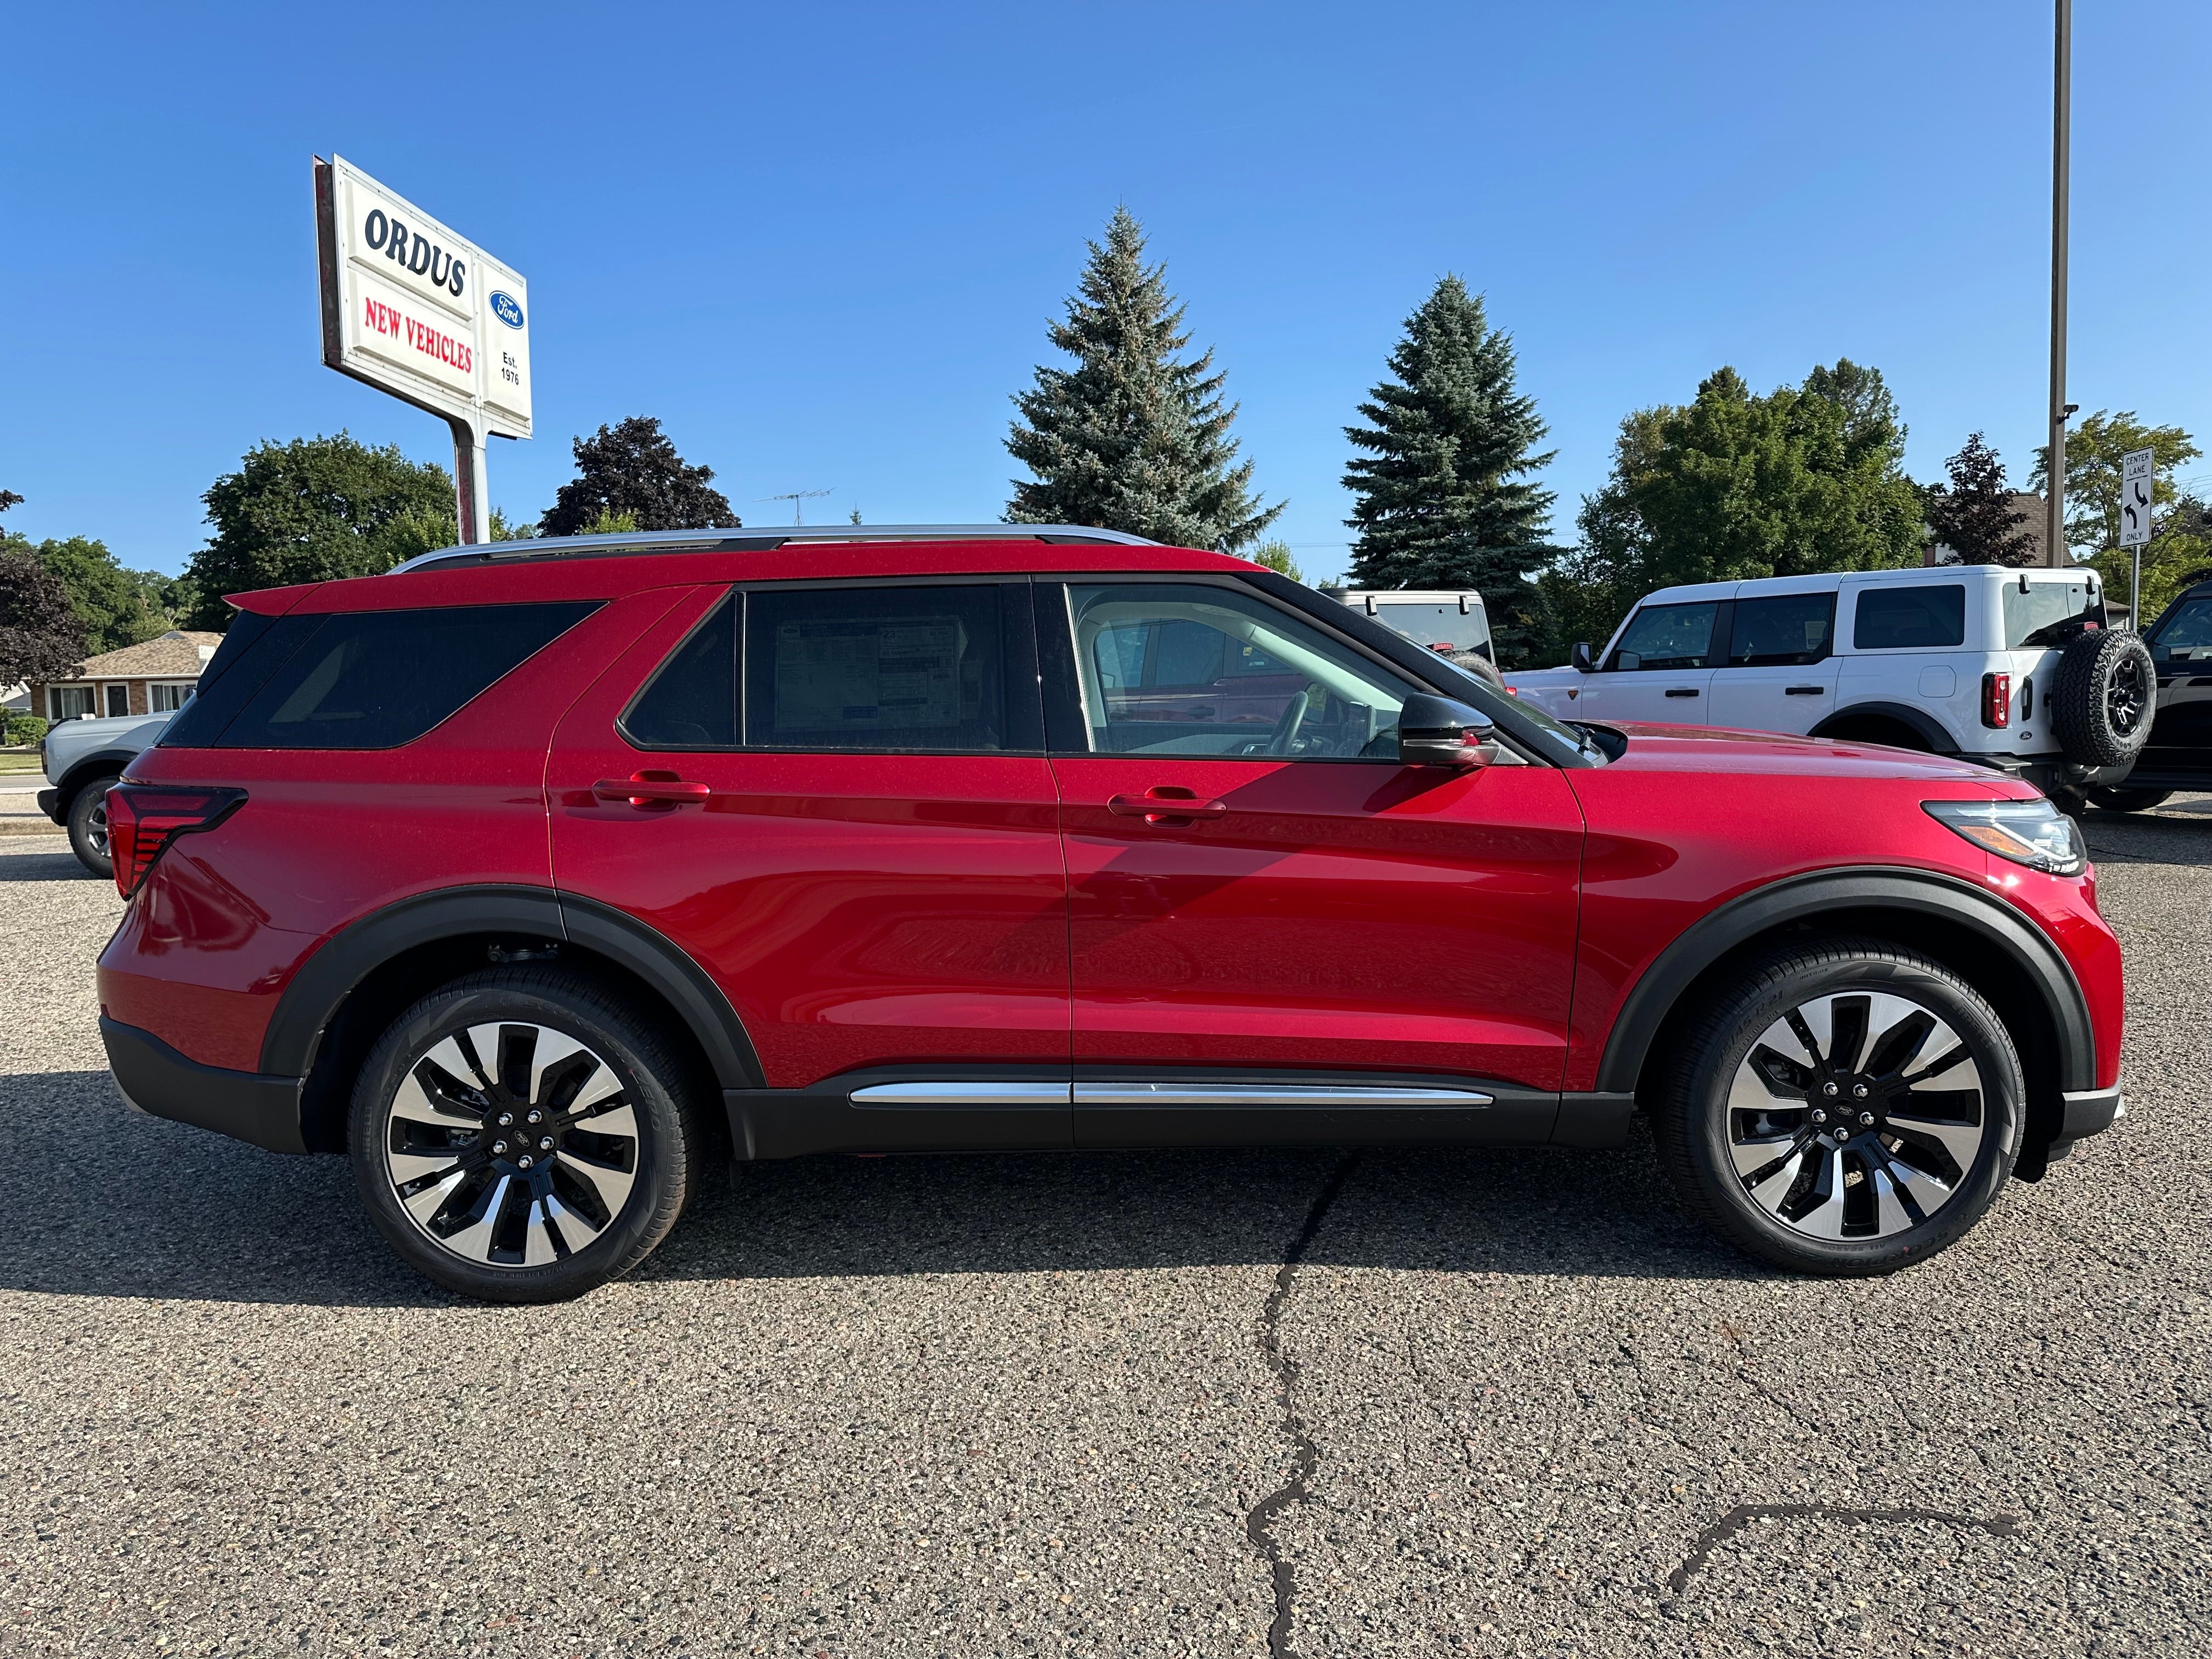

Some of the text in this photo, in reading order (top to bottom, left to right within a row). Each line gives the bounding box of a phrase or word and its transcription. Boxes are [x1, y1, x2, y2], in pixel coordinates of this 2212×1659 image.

[365, 209, 466, 297] ORDUS
[496, 295, 519, 324] Ford
[365, 297, 472, 374] NEW VEHICLES
[503, 351, 517, 369] Est.
[501, 367, 519, 385] 1976
[2126, 453, 2149, 465] CENTER
[2129, 465, 2146, 476] LANE
[2126, 531, 2143, 541] ONLY
[632, 1068, 662, 1132] ZERO
[1827, 1229, 1951, 1268] SCORPION
